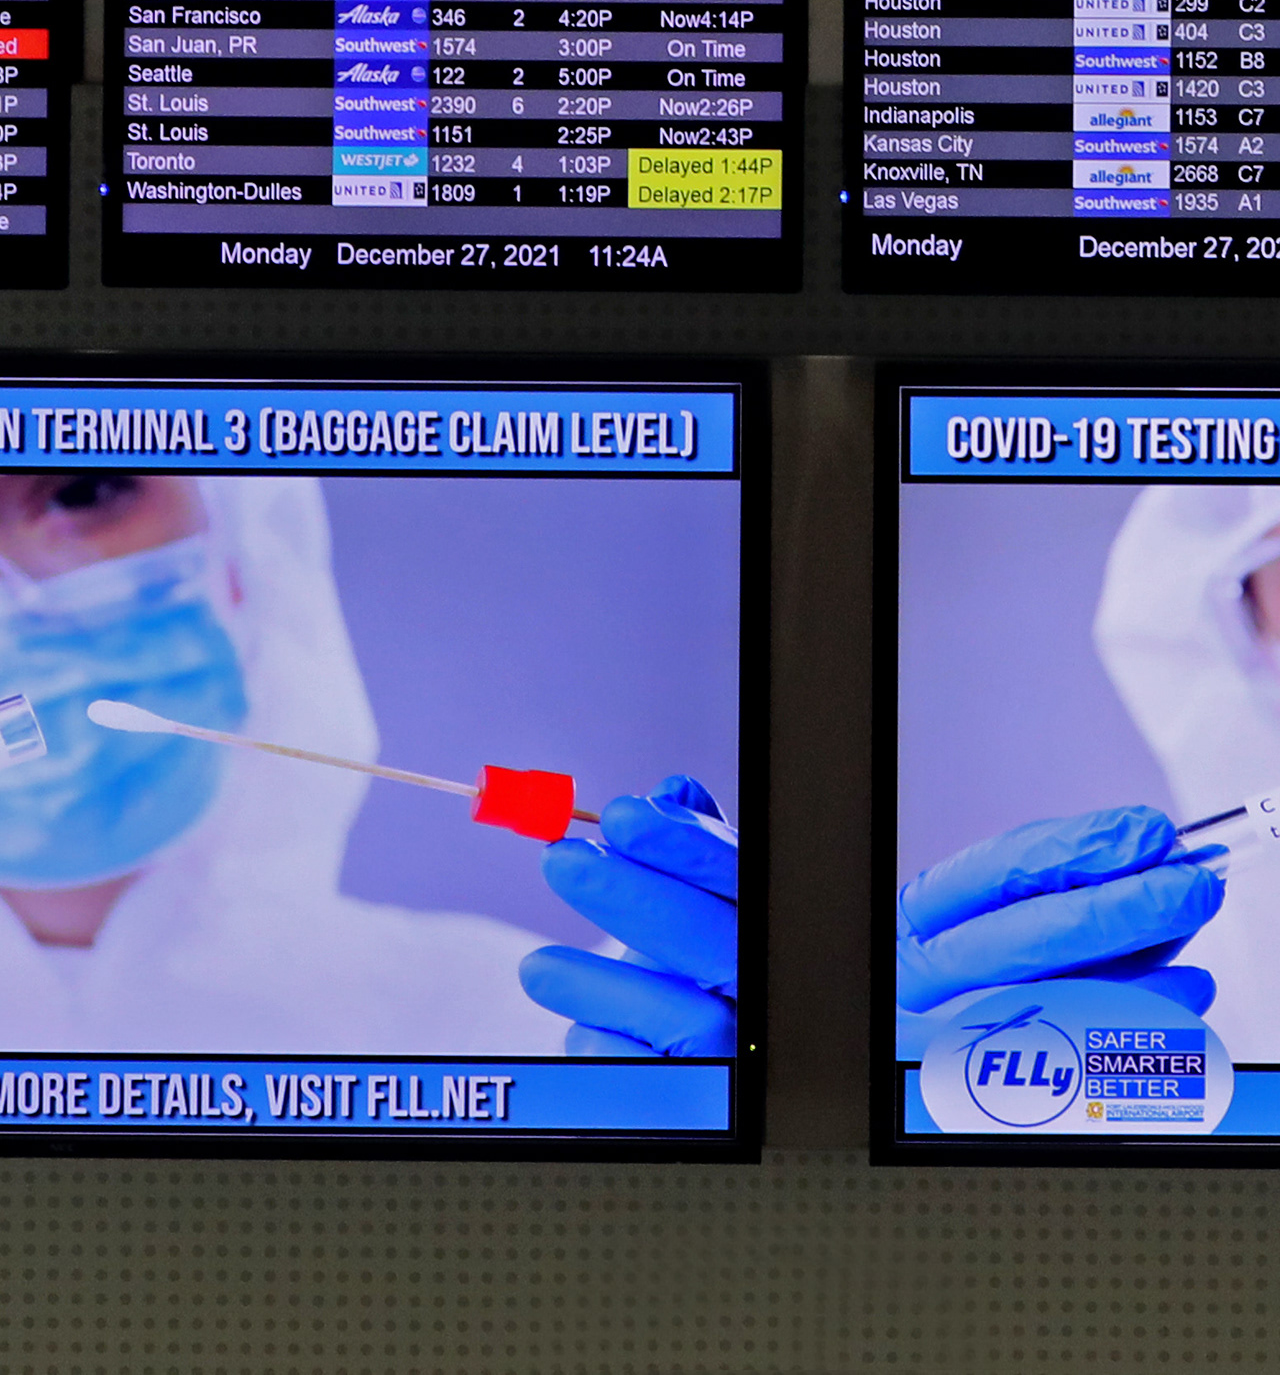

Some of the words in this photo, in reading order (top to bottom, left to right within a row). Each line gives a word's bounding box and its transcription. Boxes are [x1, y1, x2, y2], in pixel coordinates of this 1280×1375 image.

[127, 182, 301, 204] Washington-Dulles
[335, 186, 386, 195] UNITED
[431, 183, 477, 203] 1809
[514, 185, 520, 201] 1
[559, 186, 610, 202] 1:19P
[639, 186, 712, 206] Delayed
[720, 187, 772, 203] 2:17P
[32, 406, 216, 455] TERMINAL
[223, 406, 251, 455] 3
[260, 406, 440, 459] (BAGGAGE
[447, 407, 563, 456] CLAIM
[572, 408, 696, 460] LEVEL)
[947, 416, 1119, 464] COVID-19
[1127, 417, 1277, 464] TESTING
[1088, 1031, 1166, 1049] SAFER
[1088, 1055, 1202, 1073] SMARTER
[95, 1072, 258, 1123] DETAILS,
[263, 1075, 359, 1120] VISIT
[366, 1074, 514, 1121] FLL.NET
[1088, 1079, 1179, 1096] BETTER
